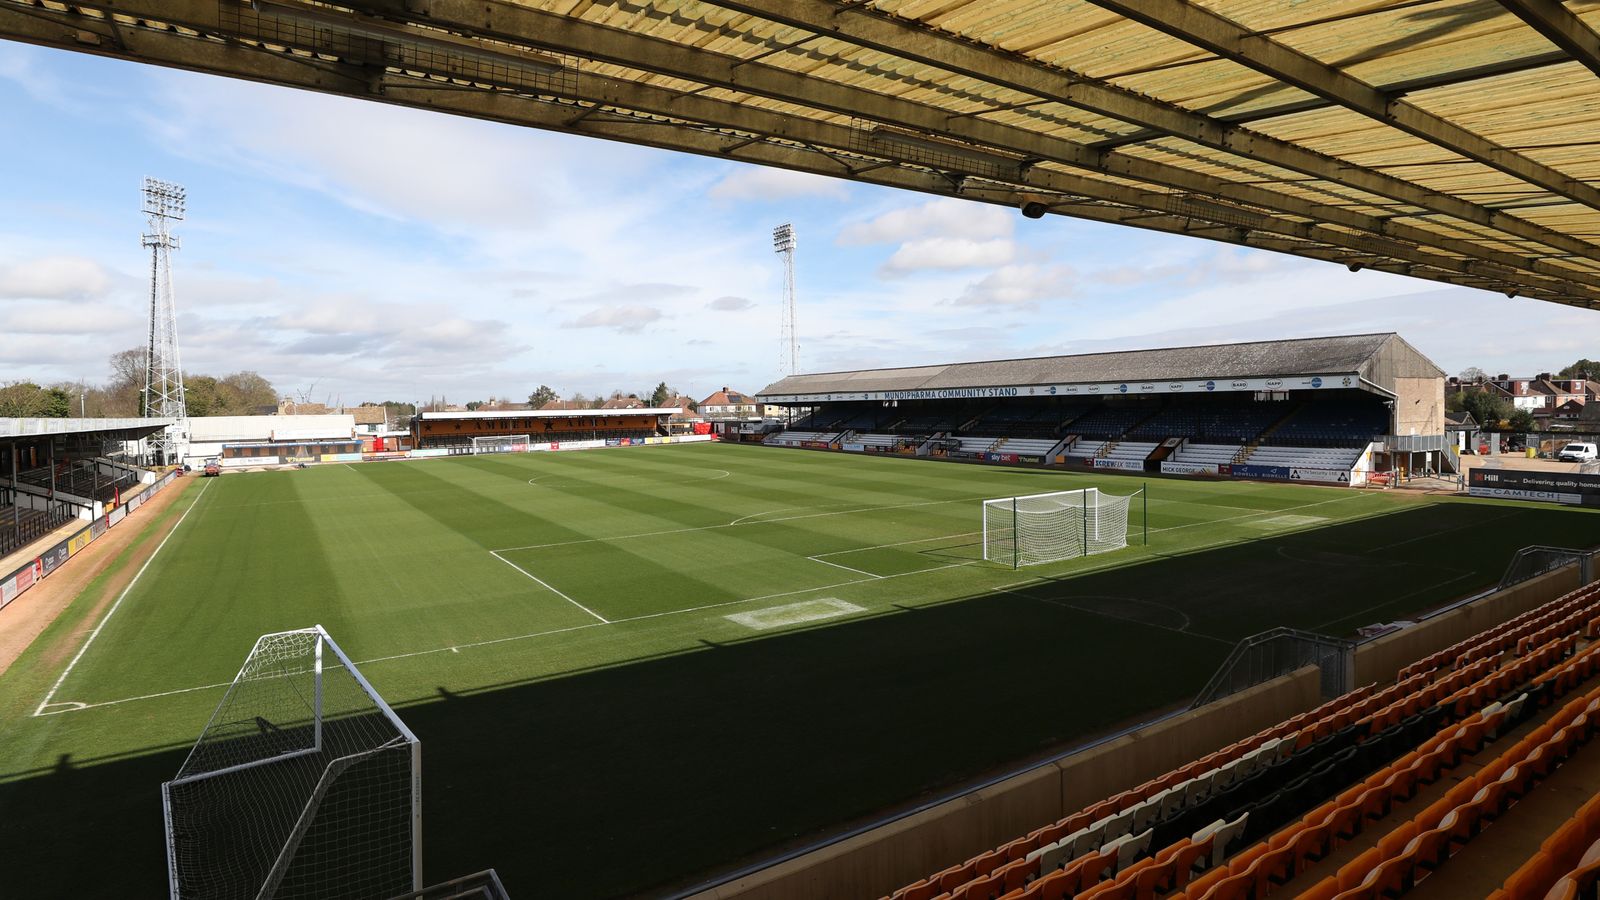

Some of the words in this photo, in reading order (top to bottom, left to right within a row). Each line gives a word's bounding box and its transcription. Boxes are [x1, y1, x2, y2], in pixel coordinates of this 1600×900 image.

[884, 391, 936, 400] MUNDIPHARMA
[938, 389, 987, 399] COMMUNITY
[988, 387, 1018, 397] STAND
[991, 454, 1000, 462] sky
[1096, 460, 1125, 468] SCREWFIX
[1522, 478, 1554, 486] Delivering
[1494, 489, 1554, 498] CAMTECH
